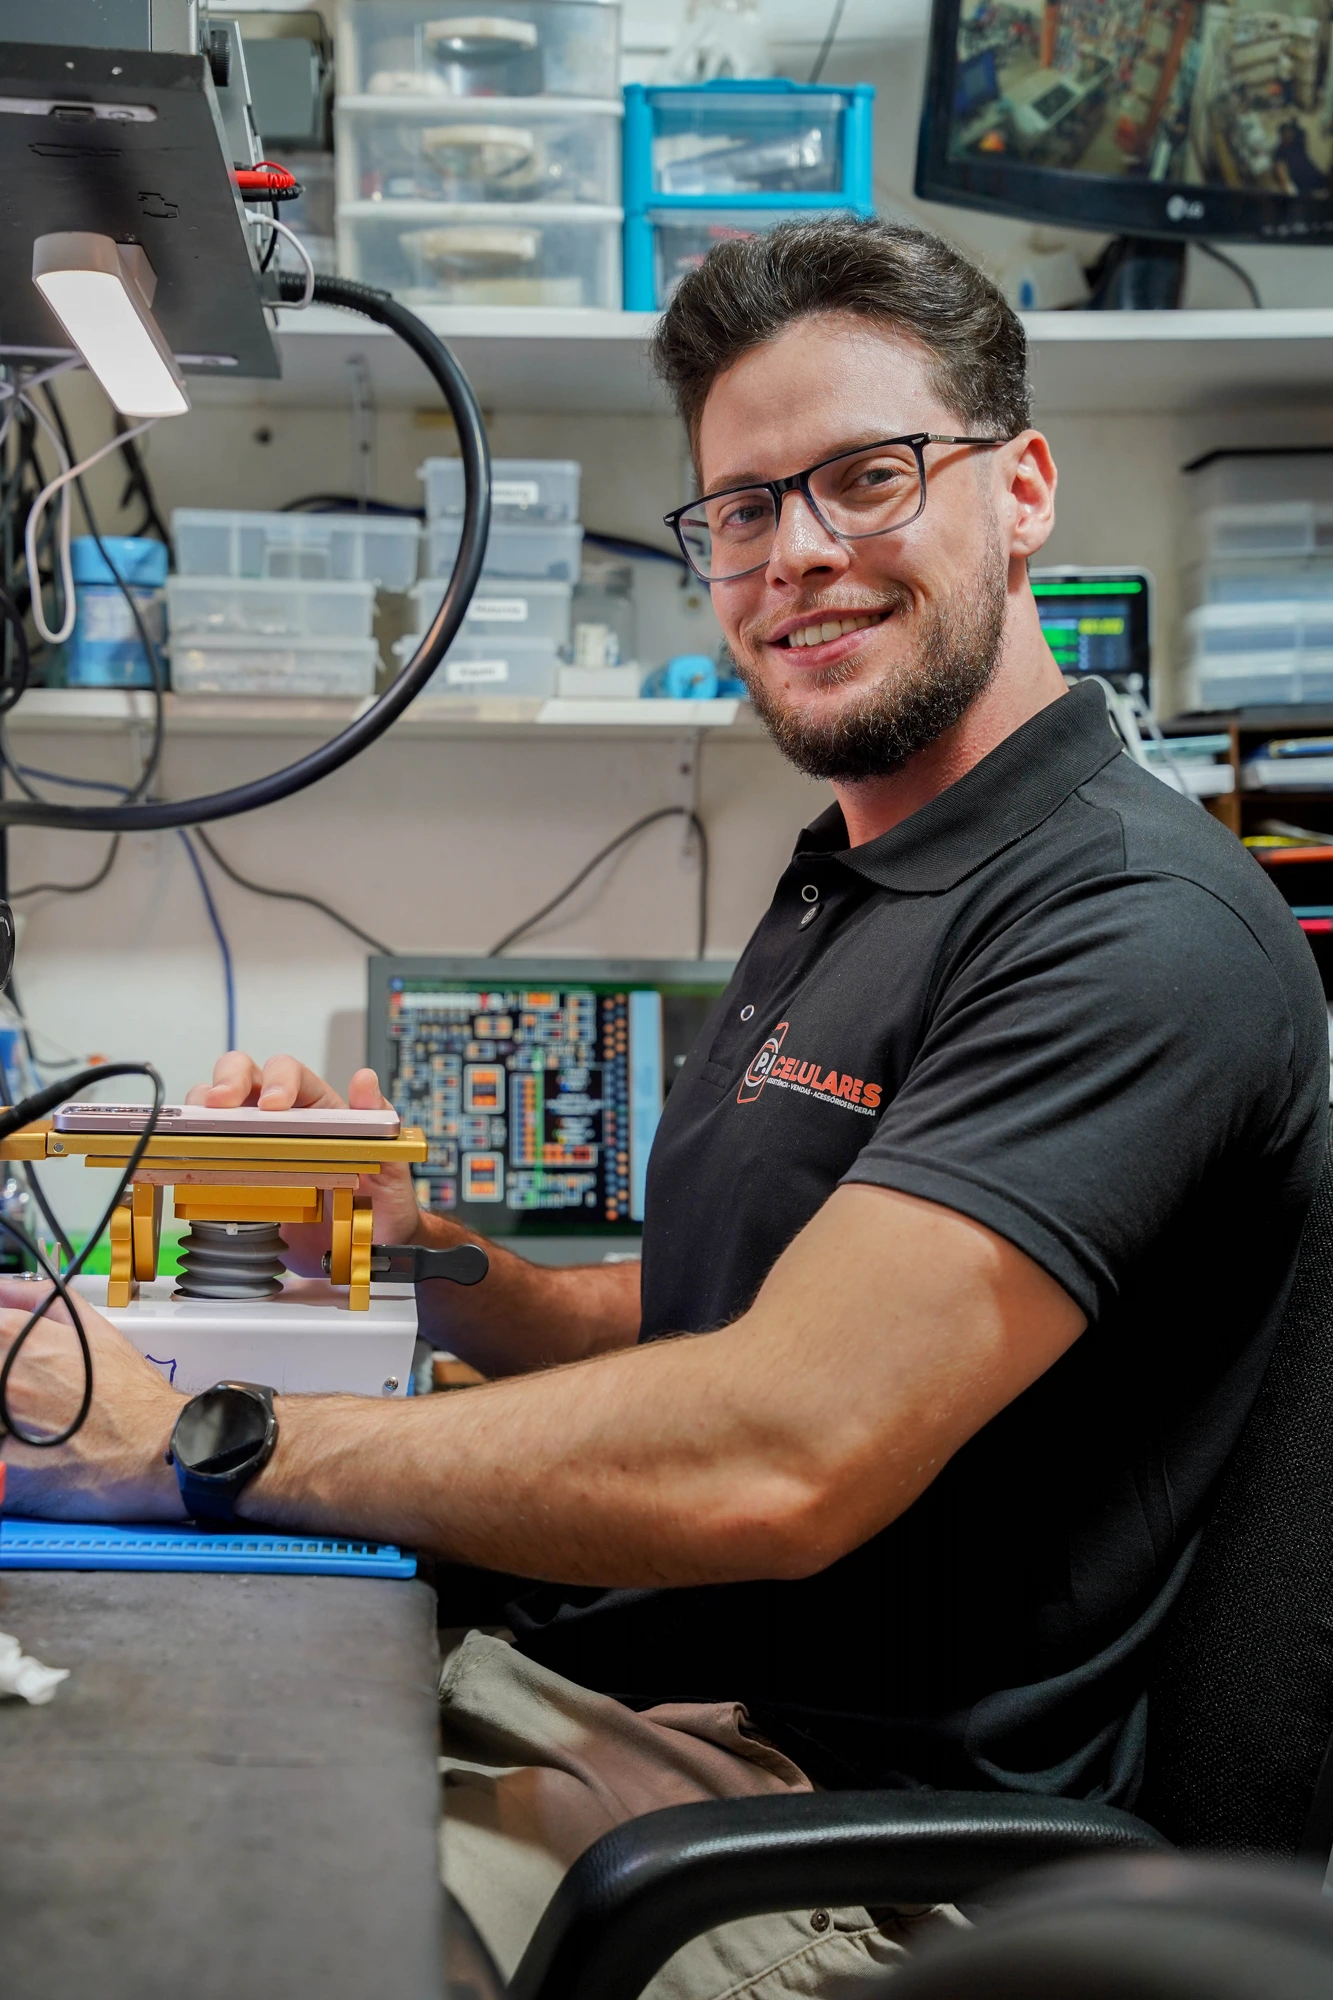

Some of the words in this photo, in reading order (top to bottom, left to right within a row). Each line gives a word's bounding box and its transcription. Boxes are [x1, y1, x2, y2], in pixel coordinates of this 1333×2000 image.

[1187, 200, 1205, 220] LG
[771, 1055, 883, 1108] CELULARES
[790, 1083, 811, 1095] VENDAS
[813, 1091, 848, 1108] ACESSÓRIOS
